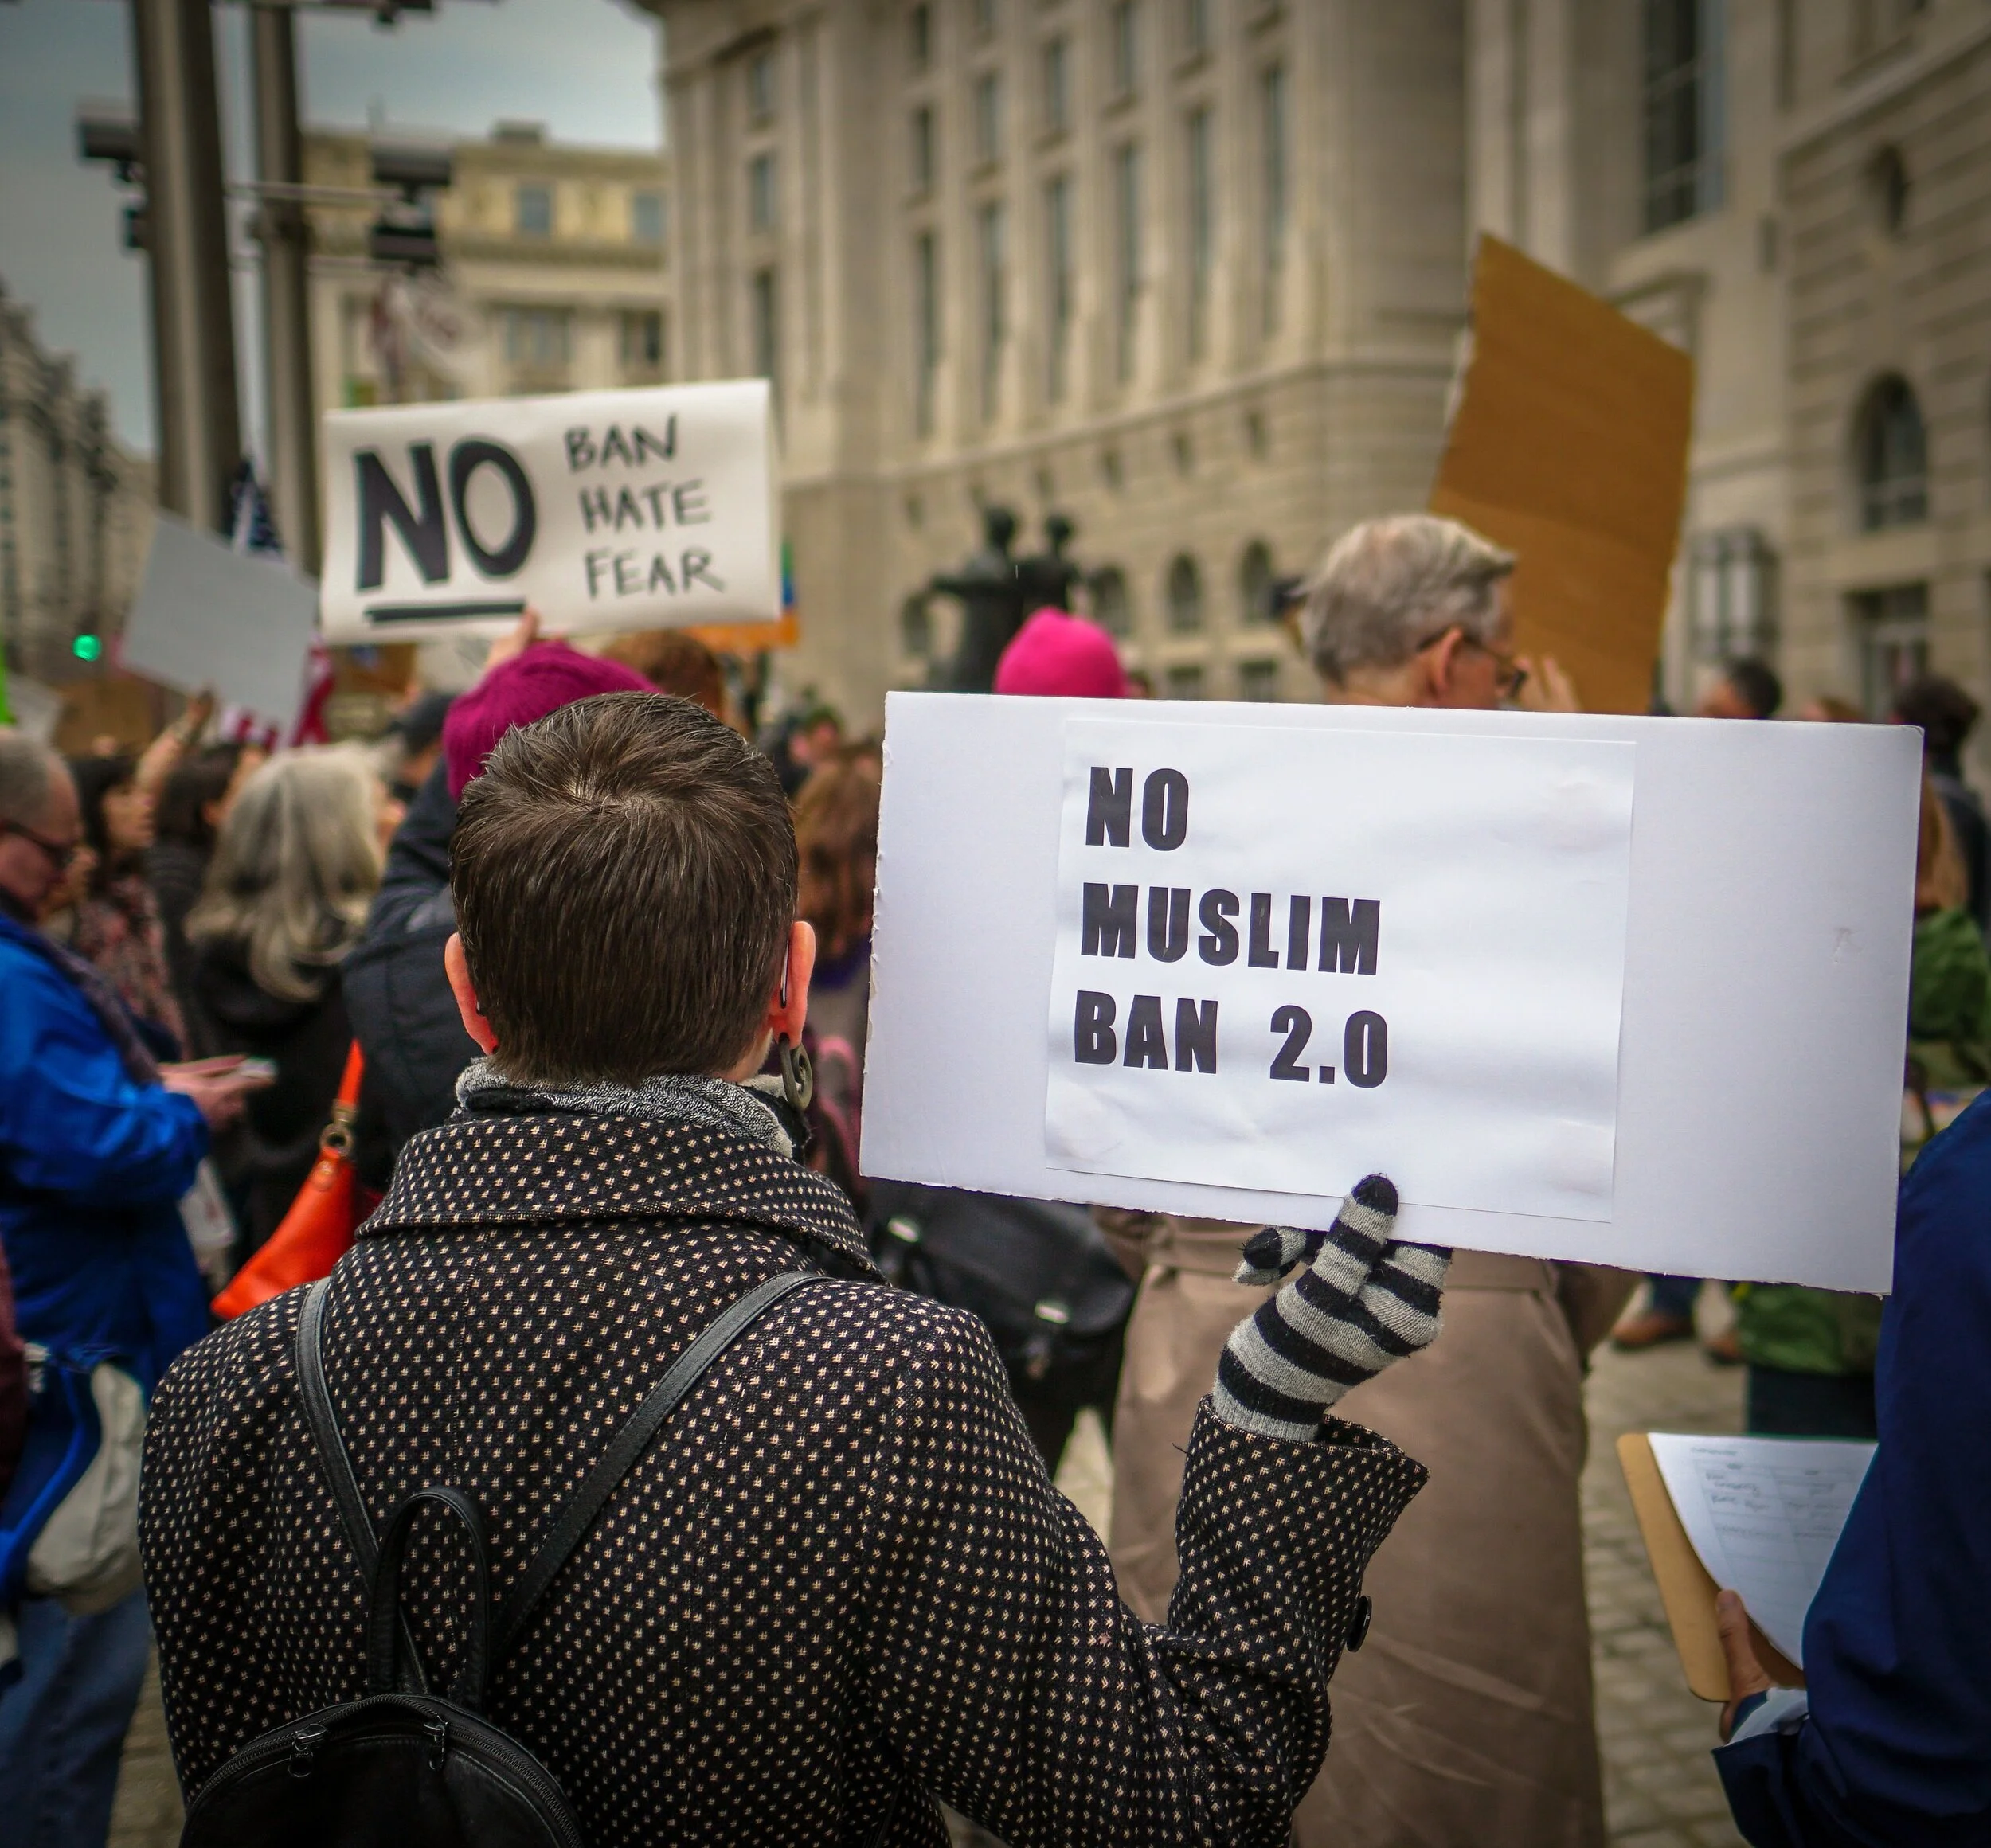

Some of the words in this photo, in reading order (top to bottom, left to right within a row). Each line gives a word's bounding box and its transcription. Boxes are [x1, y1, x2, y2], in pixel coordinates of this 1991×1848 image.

[564, 412, 678, 473] BAN
[353, 439, 538, 590] NO
[579, 479, 711, 533] HATE
[585, 547, 726, 600] FEAR
[1085, 765, 1190, 852] NO
[1080, 881, 1382, 977] MUSLIM
[1073, 989, 1219, 1076] BAN
[1269, 1004, 1389, 1089] 2.0
